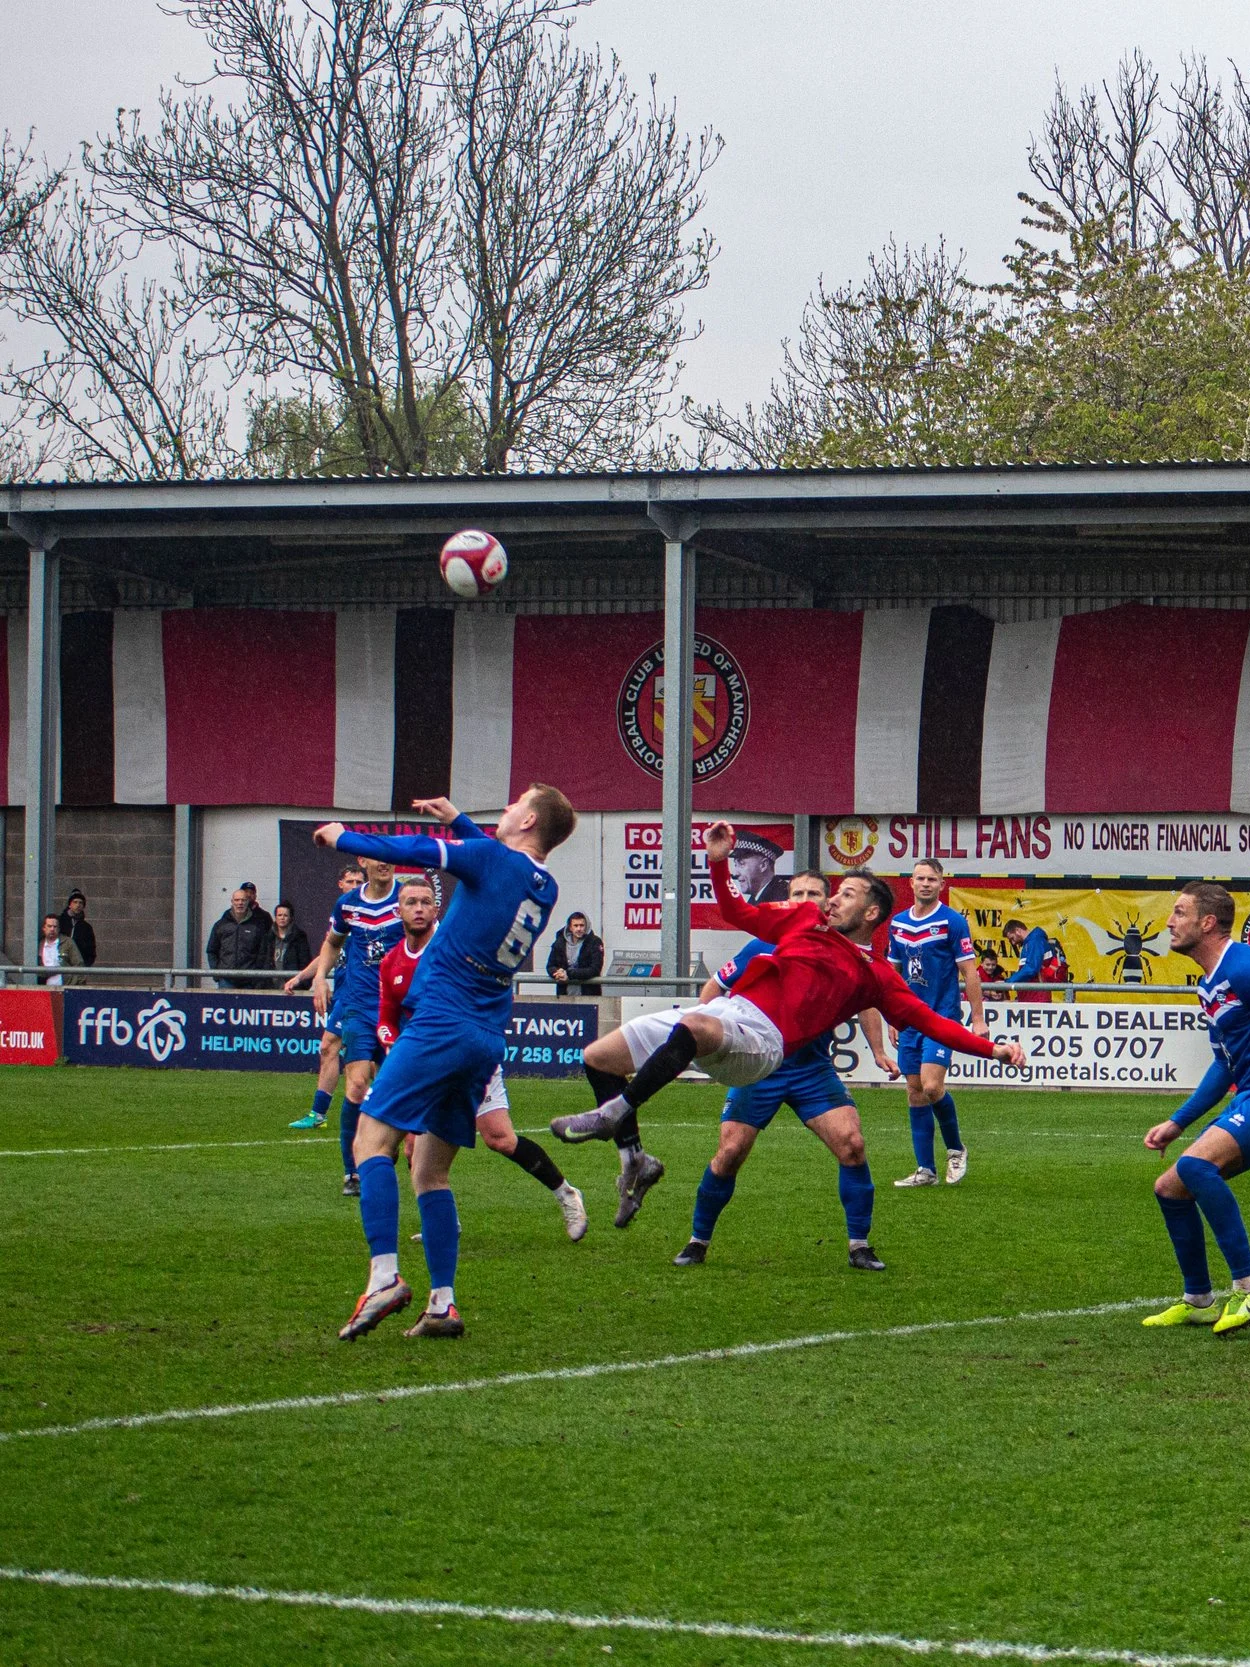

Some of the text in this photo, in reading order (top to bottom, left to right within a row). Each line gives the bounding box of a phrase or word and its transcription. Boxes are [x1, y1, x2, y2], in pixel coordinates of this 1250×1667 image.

[714, 653, 732, 671] OF
[626, 660, 654, 701] CLUB
[695, 673, 744, 774] MANCHESTER
[625, 706, 664, 770] OOTBALL
[889, 815, 968, 859] STILL
[976, 815, 1051, 860] FANS
[1064, 822, 1085, 850] NO
[1092, 823, 1149, 851] LONGER
[1157, 823, 1232, 852] FINANCIAL
[975, 908, 1003, 928] WE
[496, 898, 542, 969] 6
[973, 939, 1020, 958] STAN
[77, 1006, 134, 1046] ffb
[202, 1006, 226, 1025] FC
[230, 1008, 311, 1028] UNITED'S
[1006, 1009, 1089, 1030] METAL
[1096, 1011, 1209, 1031] DEALERS
[201, 1035, 272, 1053] HELPING
[275, 1037, 322, 1055] YOUR
[522, 1047, 552, 1063] 258
[556, 1048, 584, 1064] 164
[1031, 1035, 1084, 1057] 205
[1093, 1036, 1164, 1059] 0707
[948, 1060, 1178, 1083] bulldogmetals.co.uk
